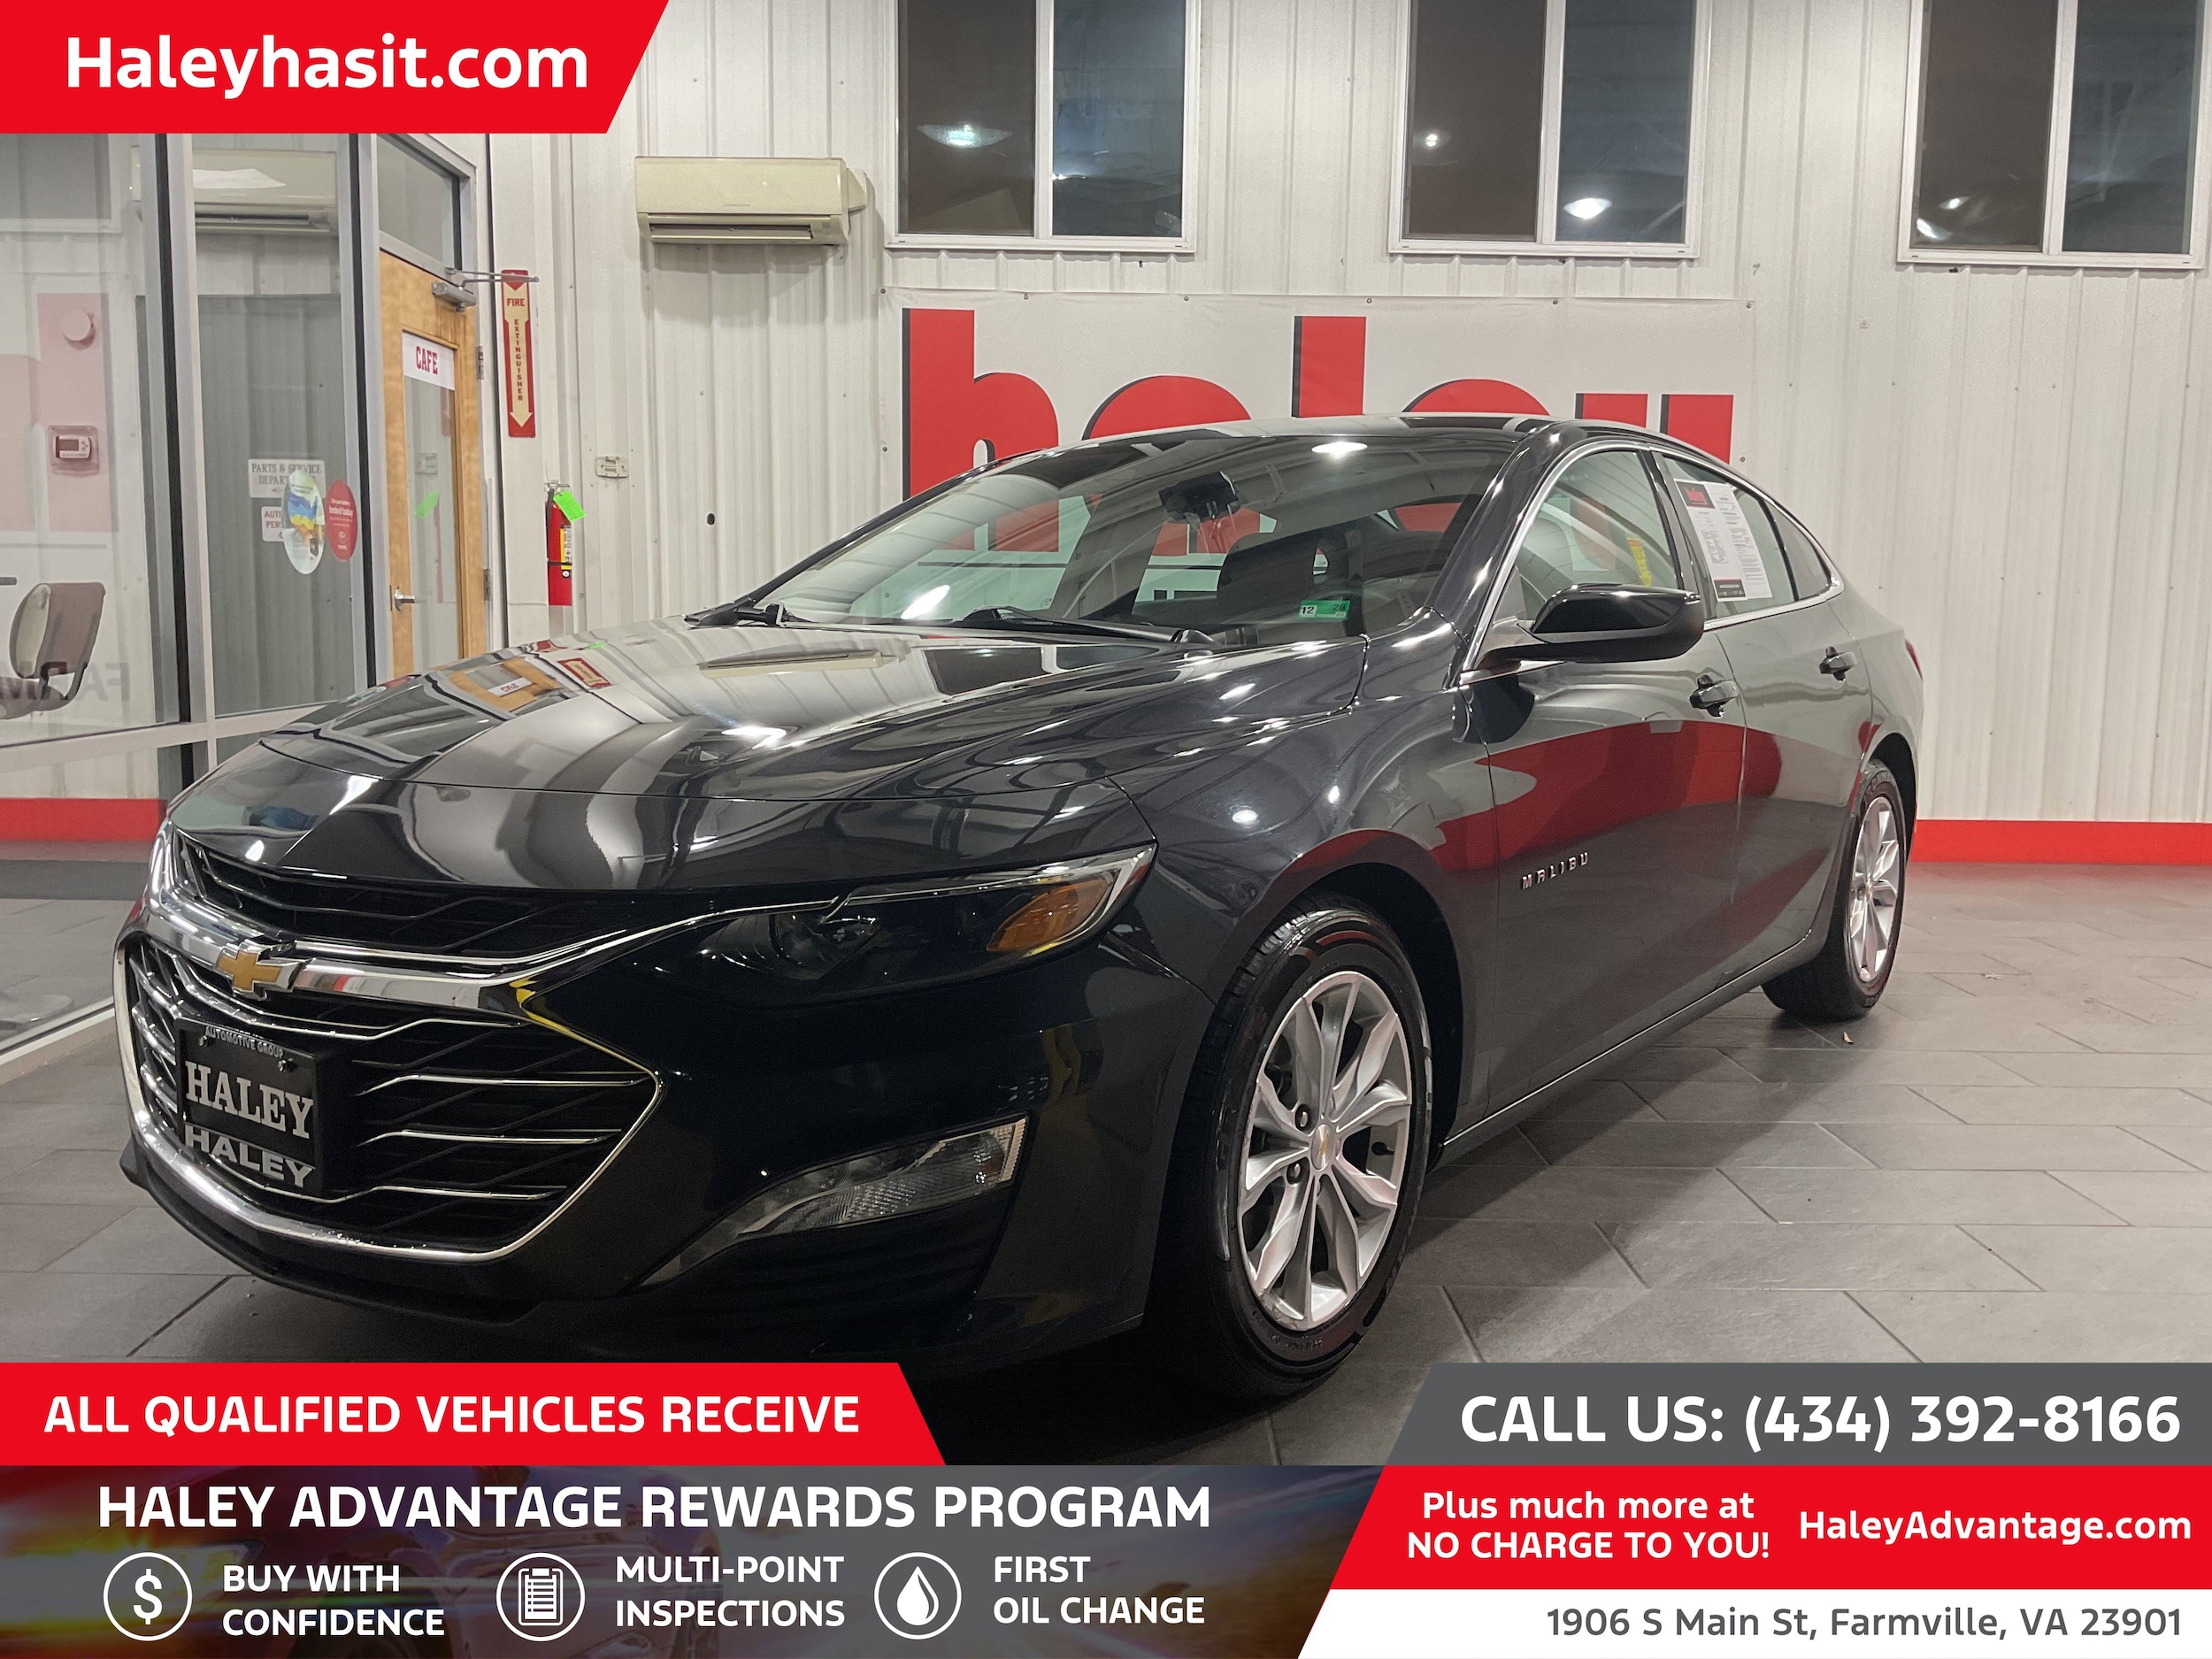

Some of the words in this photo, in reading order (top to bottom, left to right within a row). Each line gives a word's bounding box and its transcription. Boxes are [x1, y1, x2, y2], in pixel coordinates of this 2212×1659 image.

[506, 297, 526, 307] FIRE
[415, 345, 439, 375] CAFE
[513, 319, 524, 402] EXTINGUISHER
[251, 463, 277, 473] PARTS
[1301, 605, 1315, 615] 12
[1521, 851, 1589, 890] MALIBU
[204, 1025, 257, 1051] AUTOMOTIVE
[257, 1041, 284, 1059] GROUP
[184, 1060, 314, 1140] HALEY
[184, 1124, 315, 1188] HALEY
